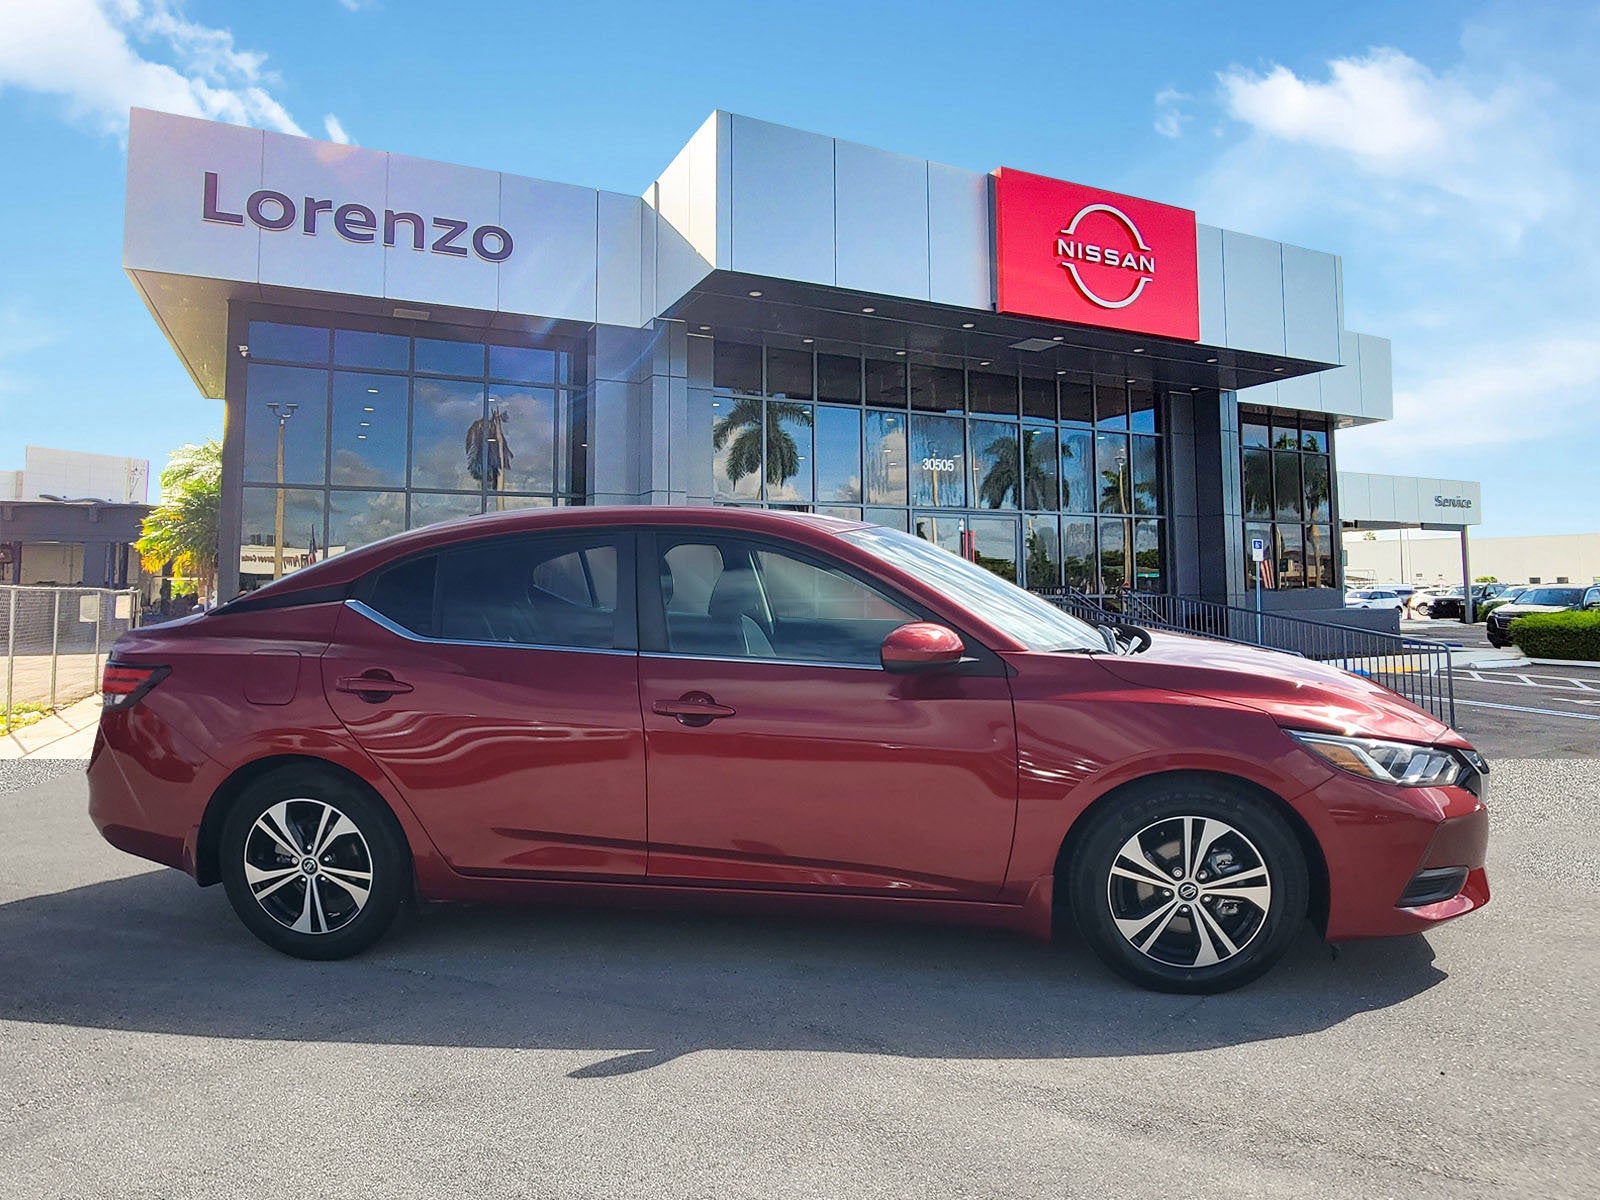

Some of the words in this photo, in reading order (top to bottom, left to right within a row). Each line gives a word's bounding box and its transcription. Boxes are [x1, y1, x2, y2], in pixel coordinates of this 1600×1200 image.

[202, 171, 514, 262] Lorenzo
[1057, 238, 1155, 273] NISSAN
[922, 457, 954, 472] 30505
[1434, 495, 1472, 509] Service
